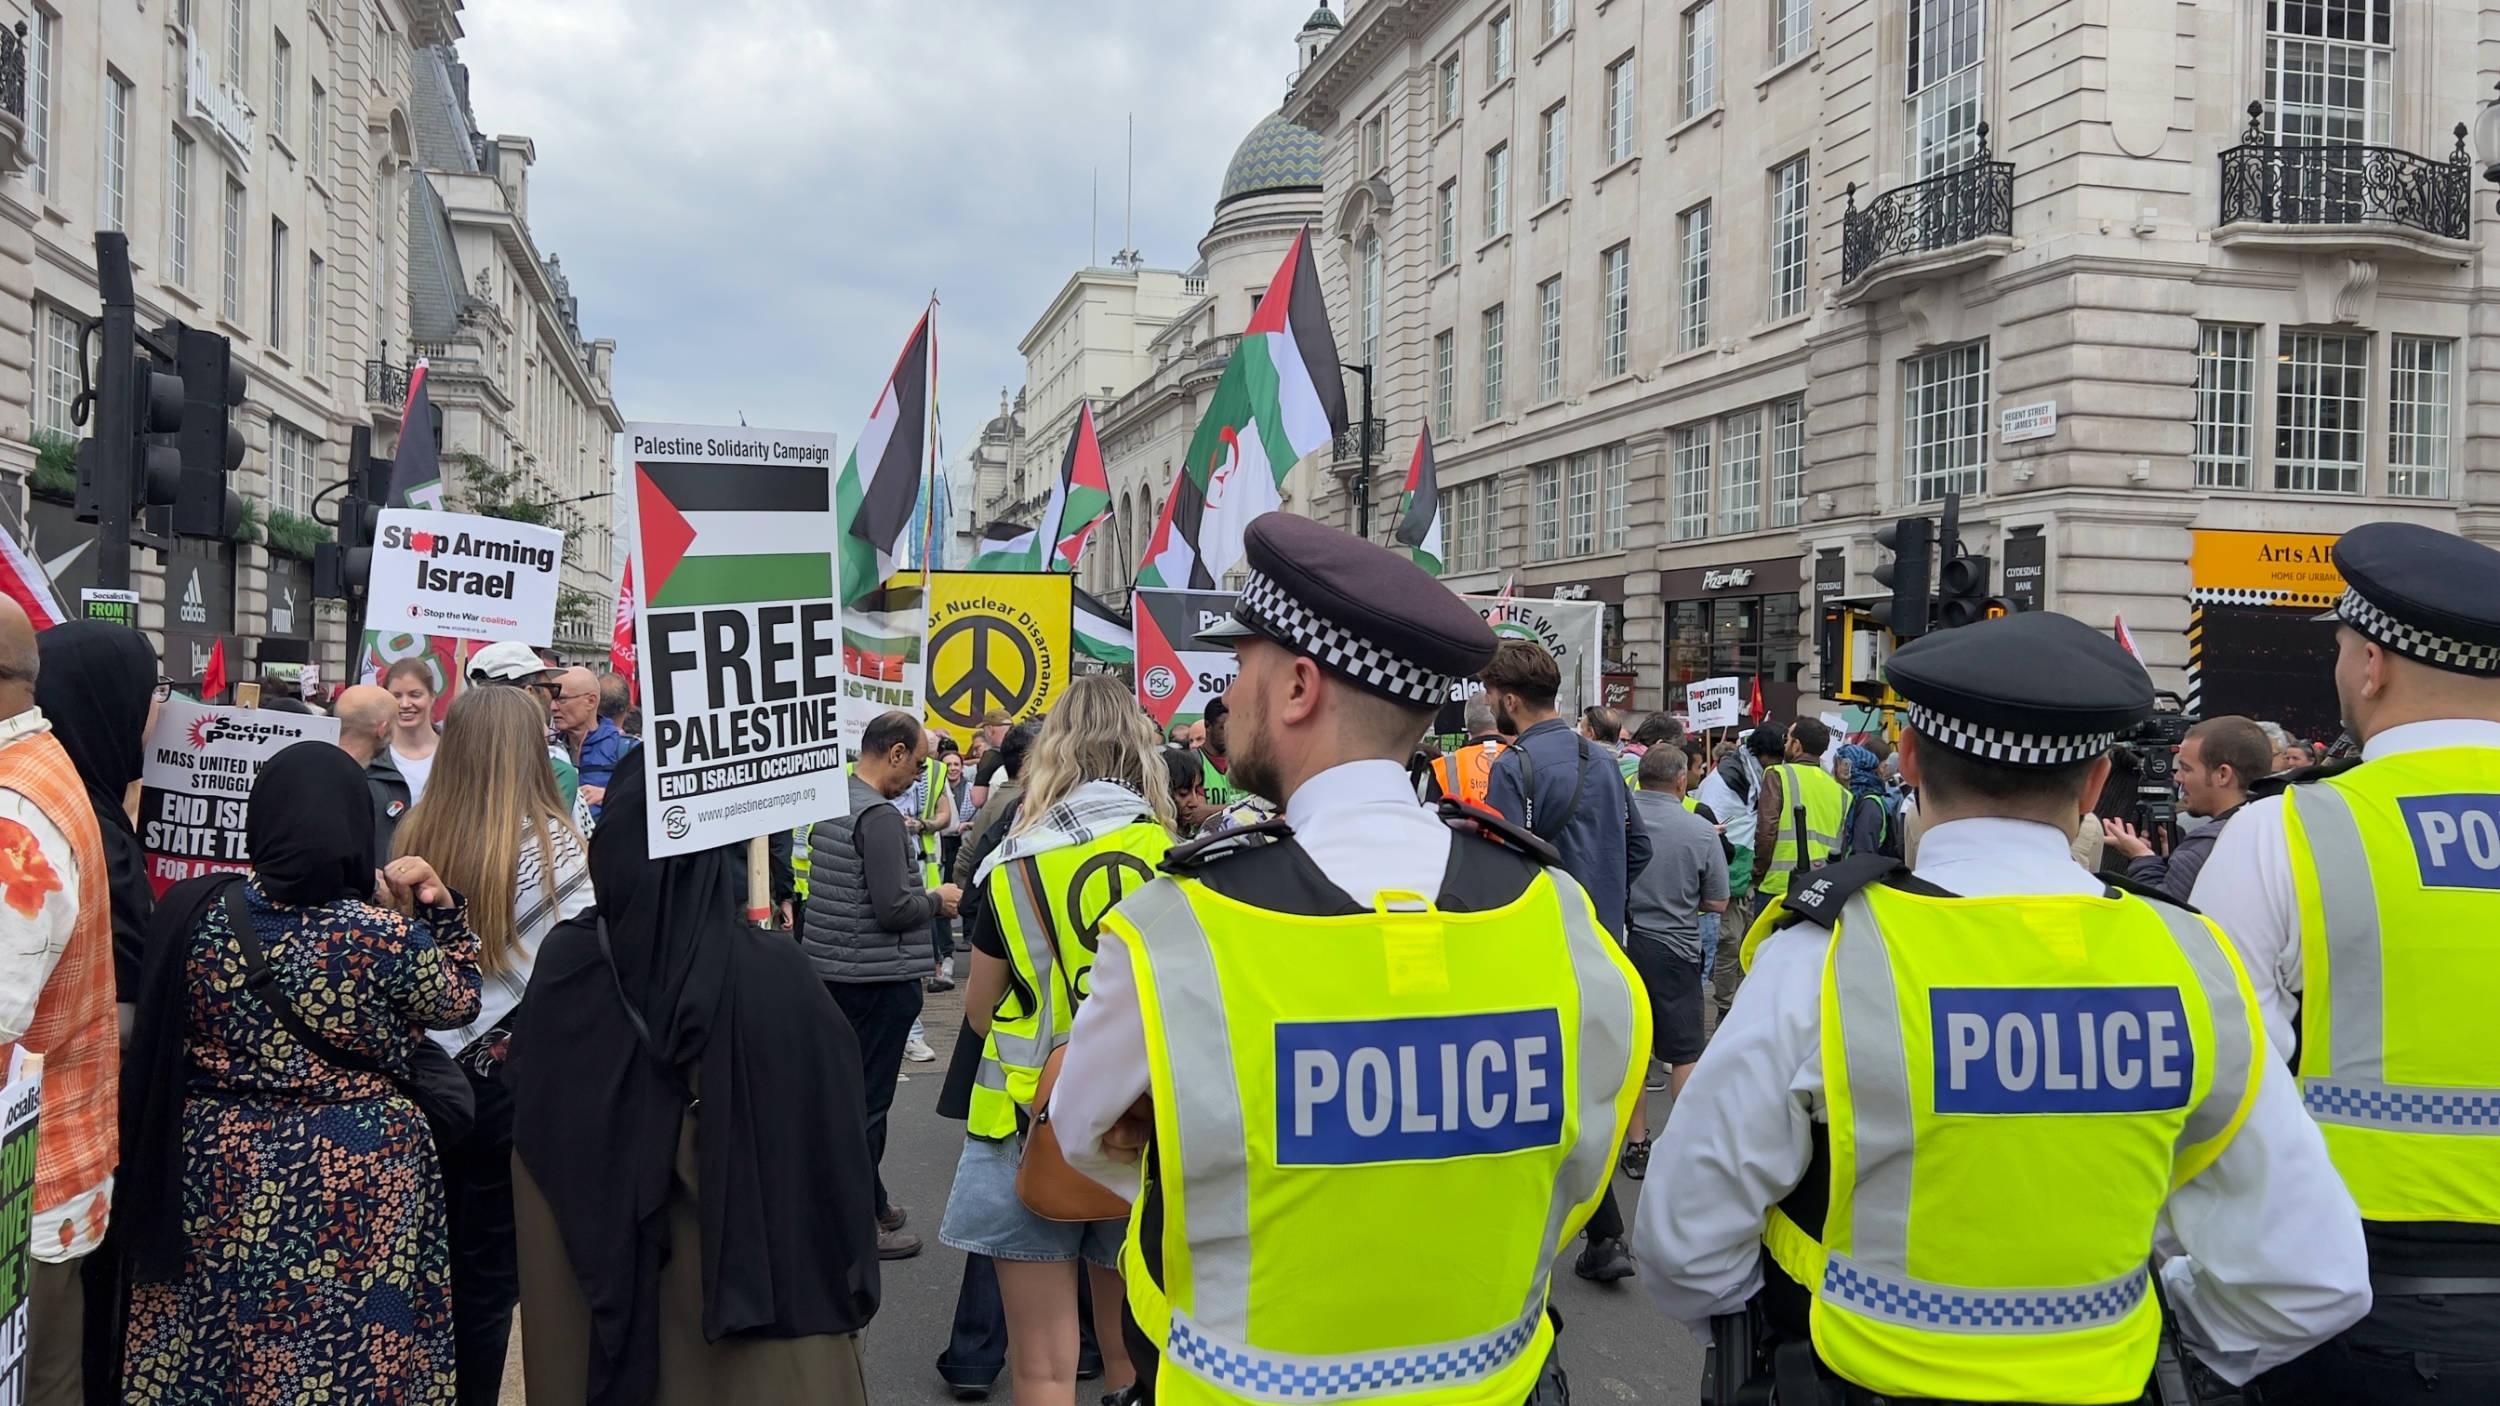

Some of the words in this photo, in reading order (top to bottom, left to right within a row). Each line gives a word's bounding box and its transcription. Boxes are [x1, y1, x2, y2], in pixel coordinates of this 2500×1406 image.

[2004, 410, 2026, 422] REGENT
[2027, 405, 2049, 417] STREET
[634, 436, 703, 455] Palestine
[707, 438, 769, 461] Solidarity
[773, 442, 829, 464] Campaign
[382, 525, 449, 558] Stp
[452, 532, 554, 573] Arming
[2257, 543, 2303, 563] Arts
[417, 560, 514, 600] Israel
[2006, 566, 2042, 577] CLYDESDALE
[2271, 571, 2294, 580] HOME
[2296, 572, 2307, 581] OF
[2308, 573, 2336, 582] URBAN
[2015, 581, 2032, 591] BANK
[88, 602, 124, 617] FROM
[181, 602, 206, 623] adidas
[423, 608, 445, 620] Stop
[446, 611, 461, 620] the
[462, 612, 479, 621] War
[481, 615, 518, 627] coalition
[928, 611, 942, 628] or
[946, 596, 1016, 616] Nuclear
[1496, 605, 1532, 625] THE
[1534, 616, 1567, 660] WAR
[647, 603, 837, 716] FREE
[843, 646, 905, 683] REE
[1150, 678, 1169, 688] PSC
[1605, 682, 1630, 695] Pizza
[1705, 684, 1735, 697] rming
[205, 730, 268, 745] Party
[214, 716, 302, 737] Socialist
[654, 697, 838, 768] PALESTINE
[157, 748, 195, 769] MASS
[199, 756, 248, 774] UNITED
[191, 773, 251, 793] STRUGGL
[661, 773, 698, 799] END
[702, 763, 758, 792] ISRAELI
[760, 747, 837, 780] OCCUPATION
[161, 793, 208, 826] END
[698, 786, 816, 824] www.palestinecampaign.org
[667, 816, 687, 830] PSC
[145, 820, 217, 857] STATE
[2417, 810, 2500, 870] PO
[155, 858, 188, 881] FOR
[1811, 878, 1833, 894] NE
[1798, 889, 1825, 907] 1913
[1947, 1011, 2181, 1091] POLICE
[1294, 1036, 1550, 1137] POLICE
